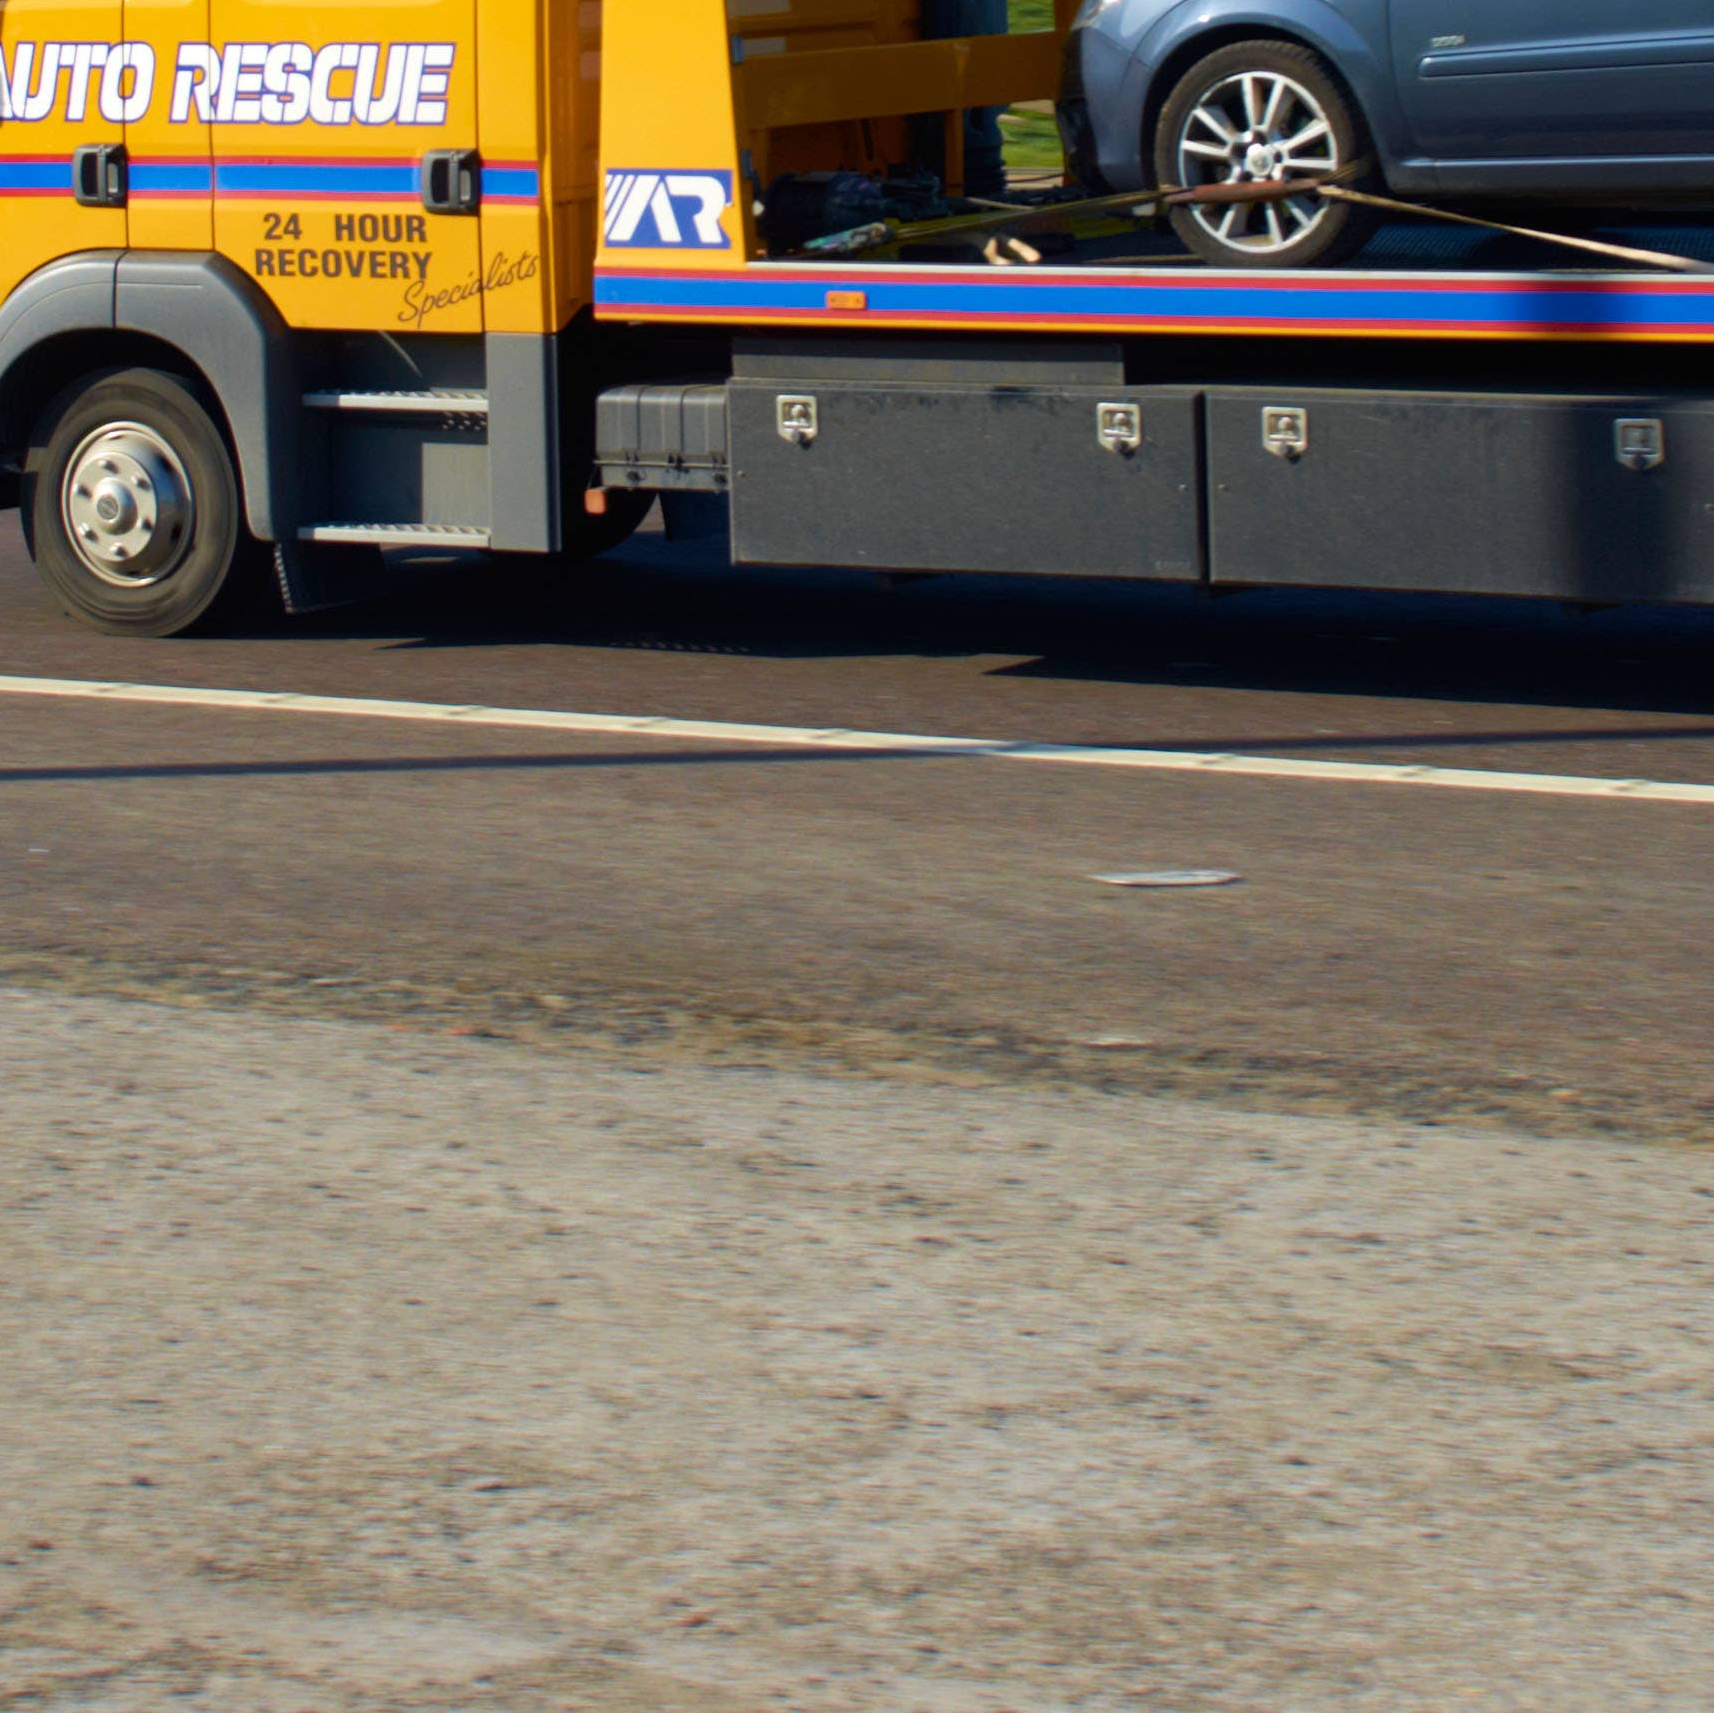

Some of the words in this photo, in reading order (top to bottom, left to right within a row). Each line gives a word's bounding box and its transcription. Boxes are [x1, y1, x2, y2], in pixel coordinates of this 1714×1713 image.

[169, 41, 457, 126] RESCUE
[263, 213, 302, 240] 24
[335, 213, 427, 243] HOUR
[255, 248, 433, 279] RECOVERY
[398, 251, 539, 329] Specialists
